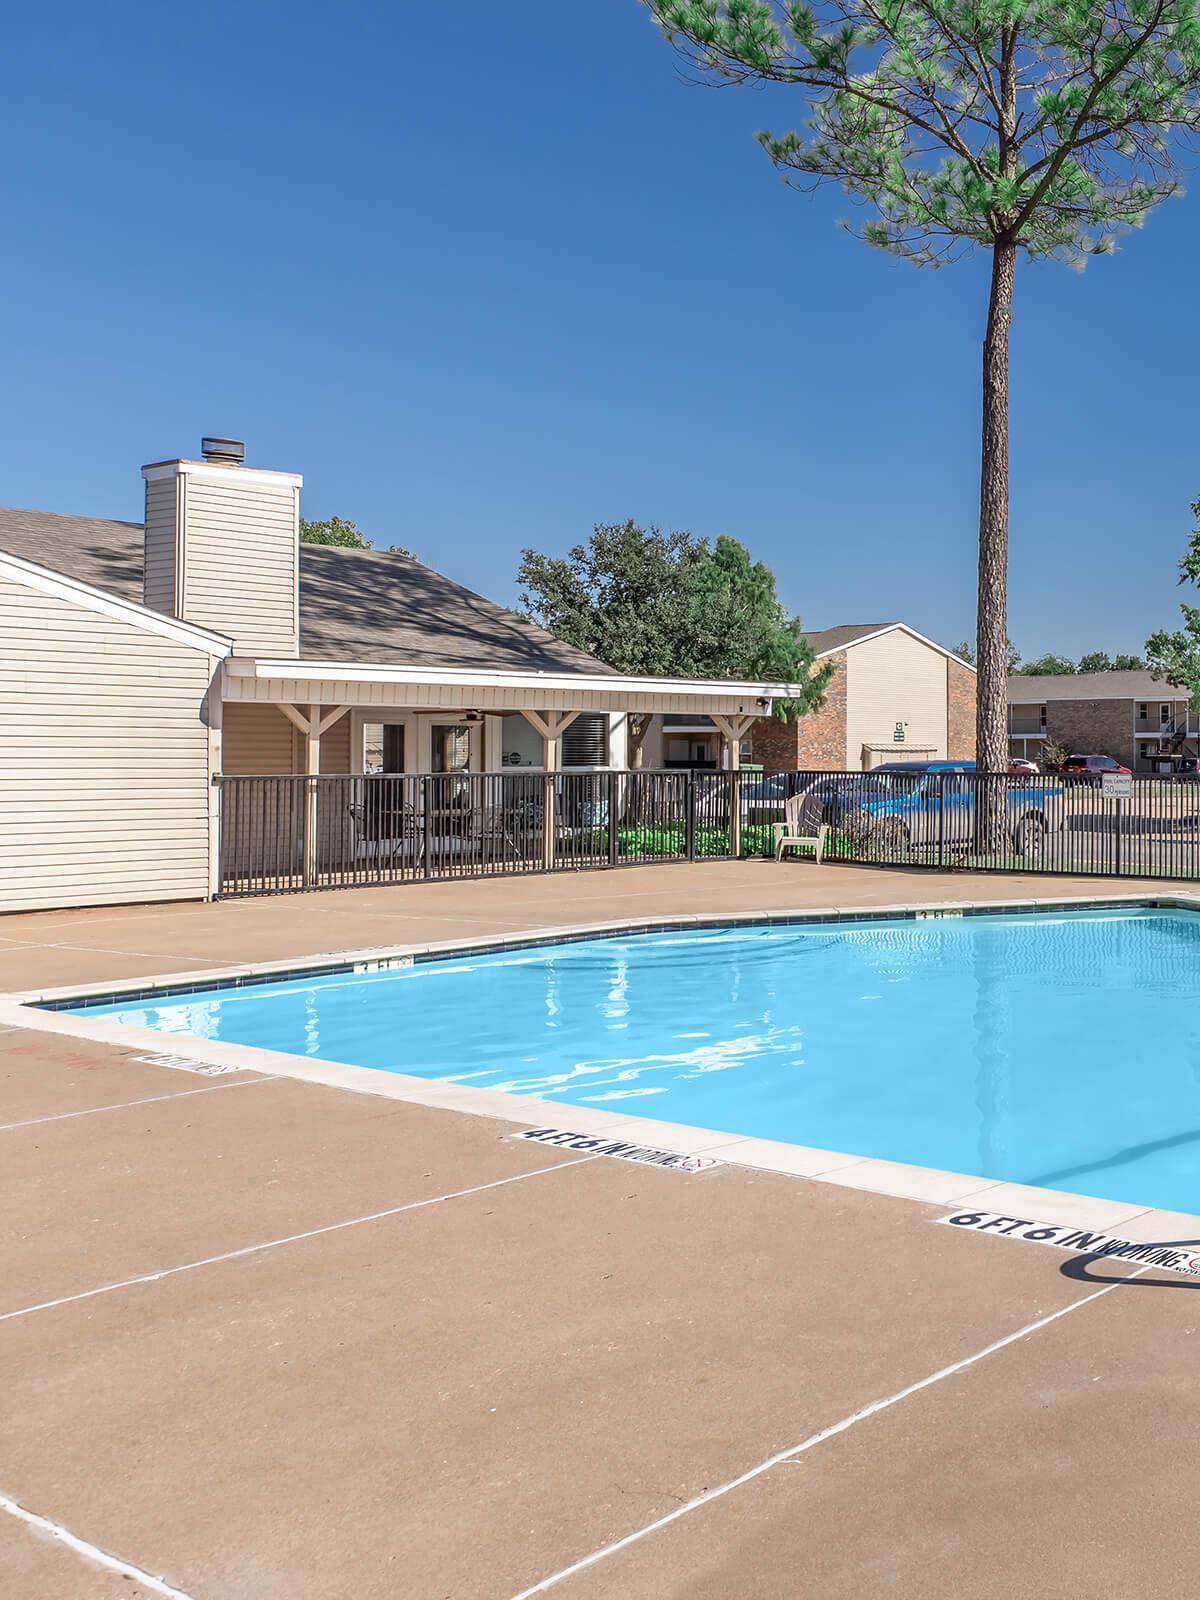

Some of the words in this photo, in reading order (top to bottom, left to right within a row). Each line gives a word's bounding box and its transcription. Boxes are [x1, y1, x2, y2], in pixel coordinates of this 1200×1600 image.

[1104, 785, 1115, 794] 30
[522, 1129, 559, 1139] 4
[569, 1139, 609, 1149] 6
[949, 1212, 990, 1226] 6
[1022, 1227, 1065, 1240] 6
